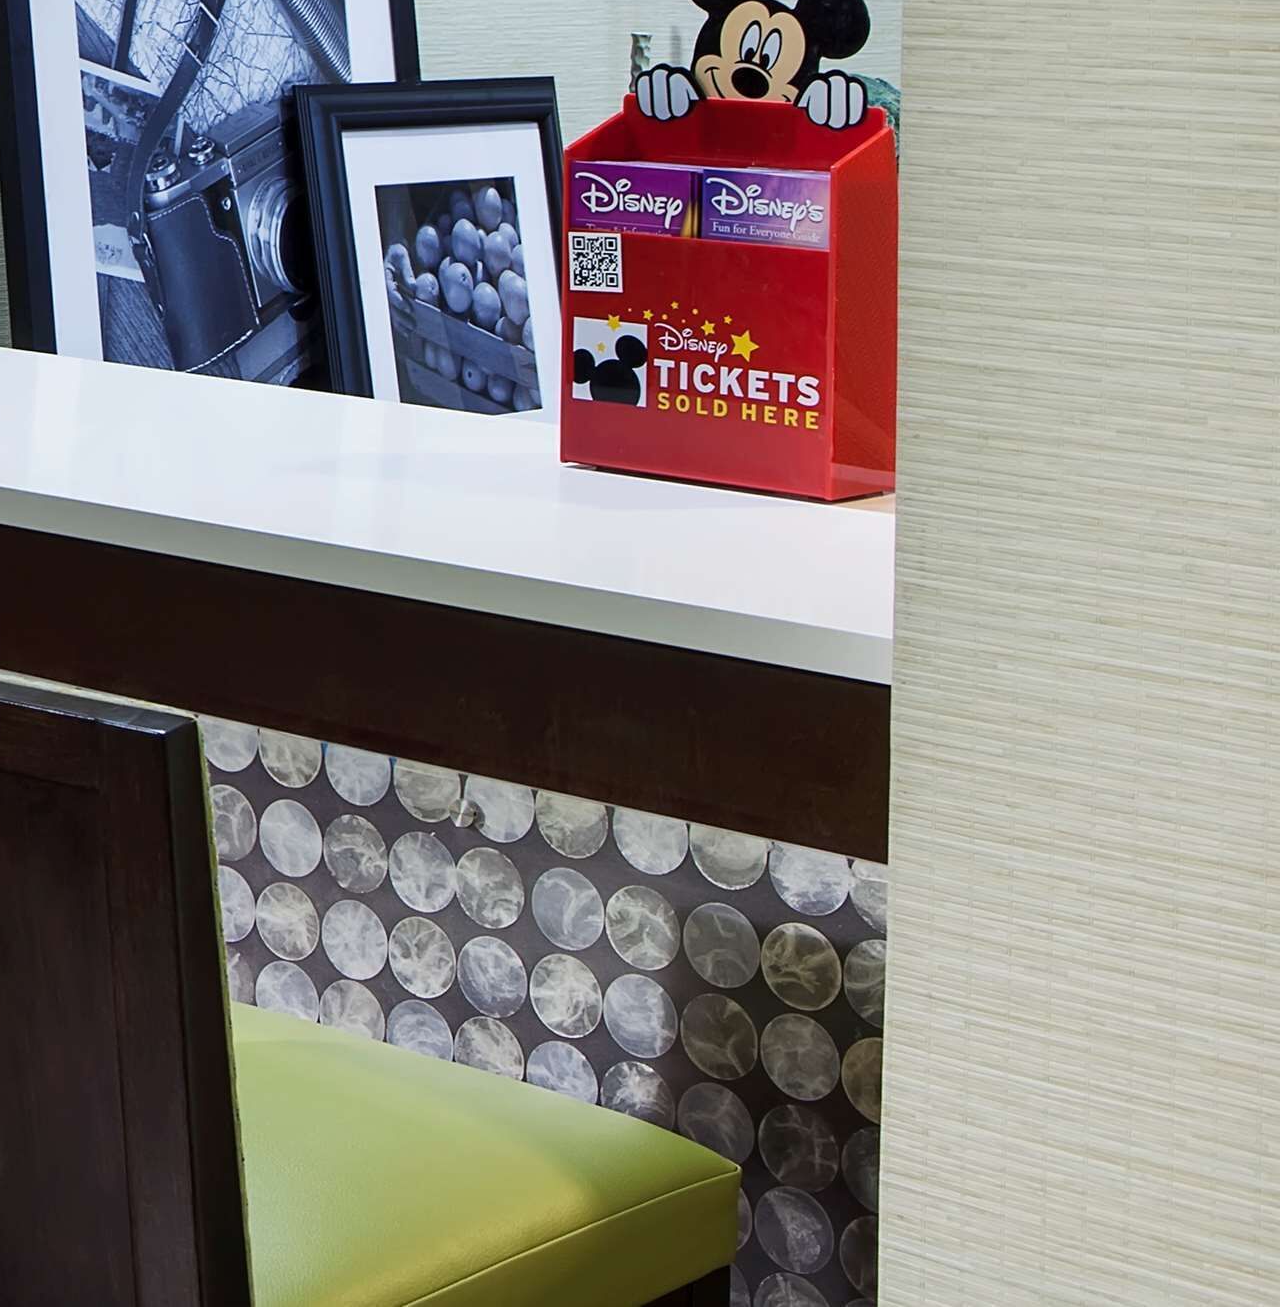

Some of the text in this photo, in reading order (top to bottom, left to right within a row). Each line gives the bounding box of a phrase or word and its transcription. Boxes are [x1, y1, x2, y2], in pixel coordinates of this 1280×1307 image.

[575, 172, 683, 229] Disney
[705, 176, 824, 233] Disney's
[713, 221, 821, 243] Fun for Everyone Guide
[654, 322, 728, 363] Disney
[653, 358, 820, 407] TICKETS
[657, 393, 819, 430] SOLD HERE
